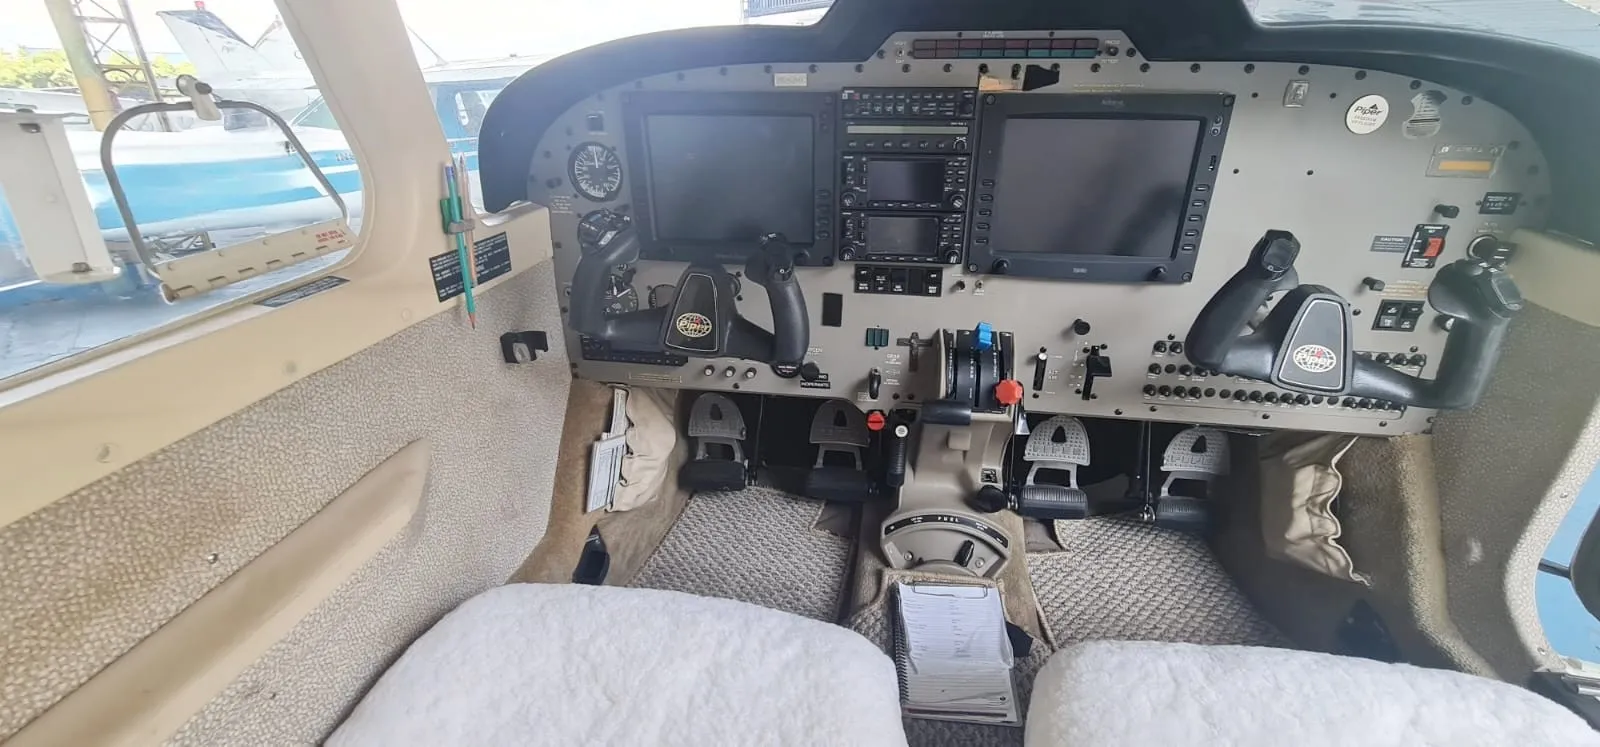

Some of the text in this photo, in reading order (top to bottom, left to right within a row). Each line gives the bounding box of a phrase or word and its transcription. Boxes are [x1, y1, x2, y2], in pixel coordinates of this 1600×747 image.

[1354, 104, 1384, 116] Piper
[679, 320, 709, 332] Piper
[1296, 352, 1330, 365] Piper
